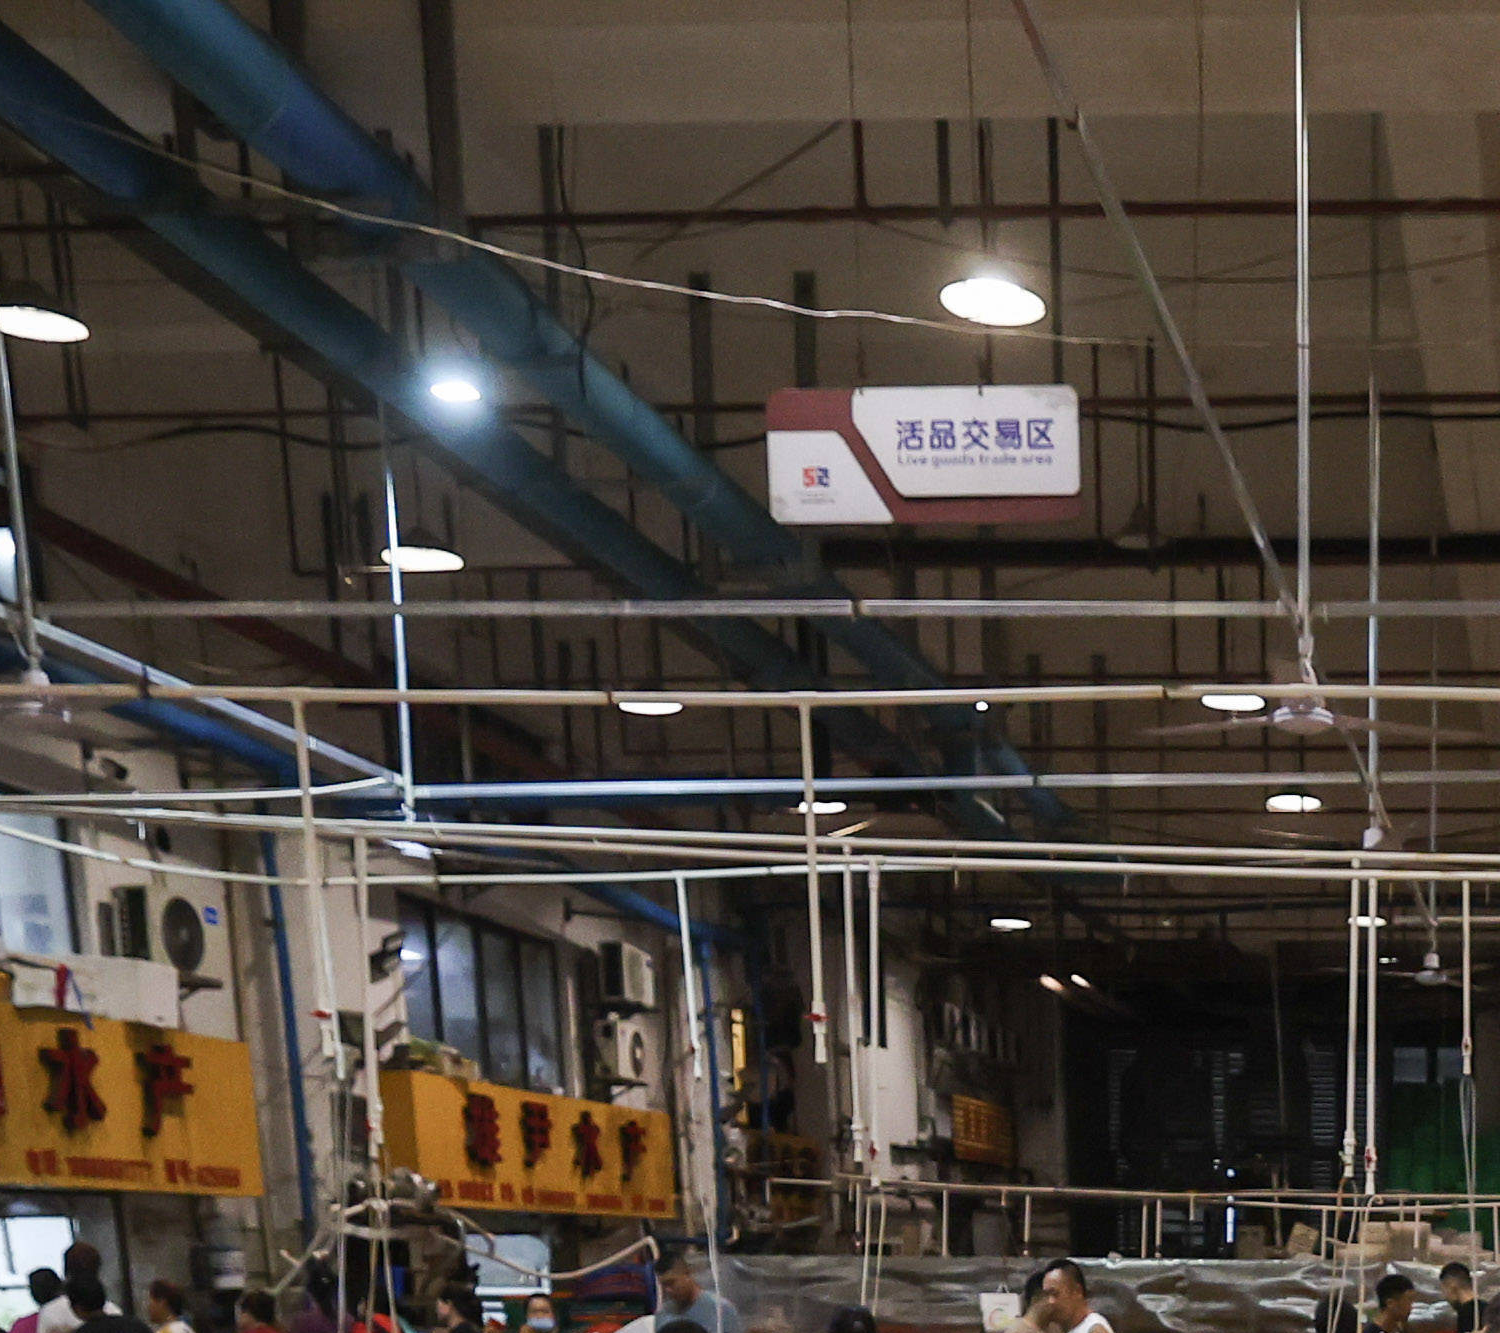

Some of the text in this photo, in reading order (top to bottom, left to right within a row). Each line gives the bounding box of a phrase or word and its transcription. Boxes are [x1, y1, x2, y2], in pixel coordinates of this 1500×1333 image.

[897, 418, 1054, 450] 活品交易区
[979, 454, 1017, 465] trade
[1021, 455, 1054, 465] area
